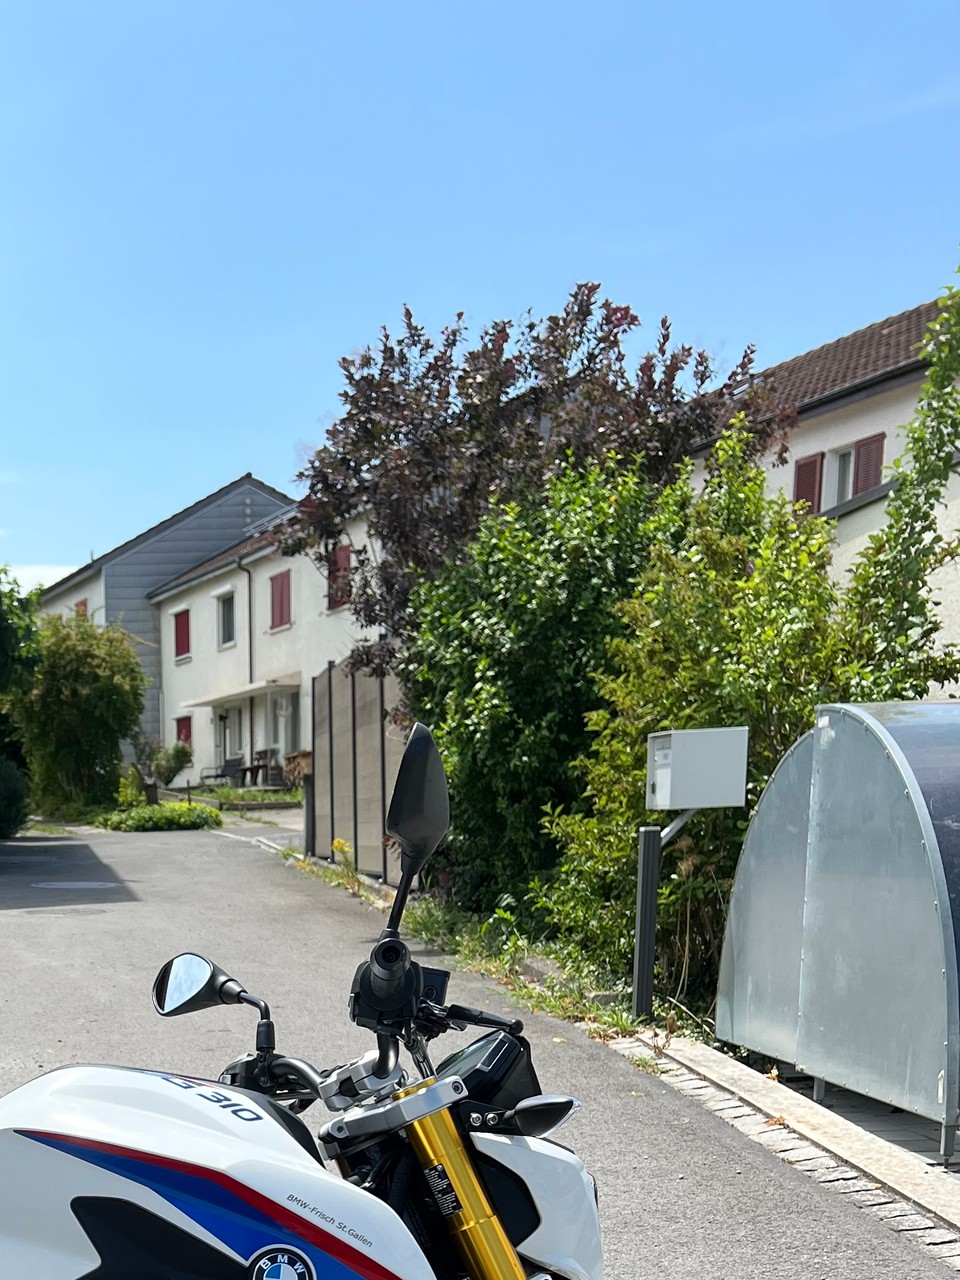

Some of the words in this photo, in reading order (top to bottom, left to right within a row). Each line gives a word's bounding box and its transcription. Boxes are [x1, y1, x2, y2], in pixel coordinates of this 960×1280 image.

[195, 1091, 263, 1121] 310
[286, 1194, 335, 1225] BMW-Frisch
[336, 1221, 373, 1248] St.Gallen
[260, 1254, 305, 1273] BMW
